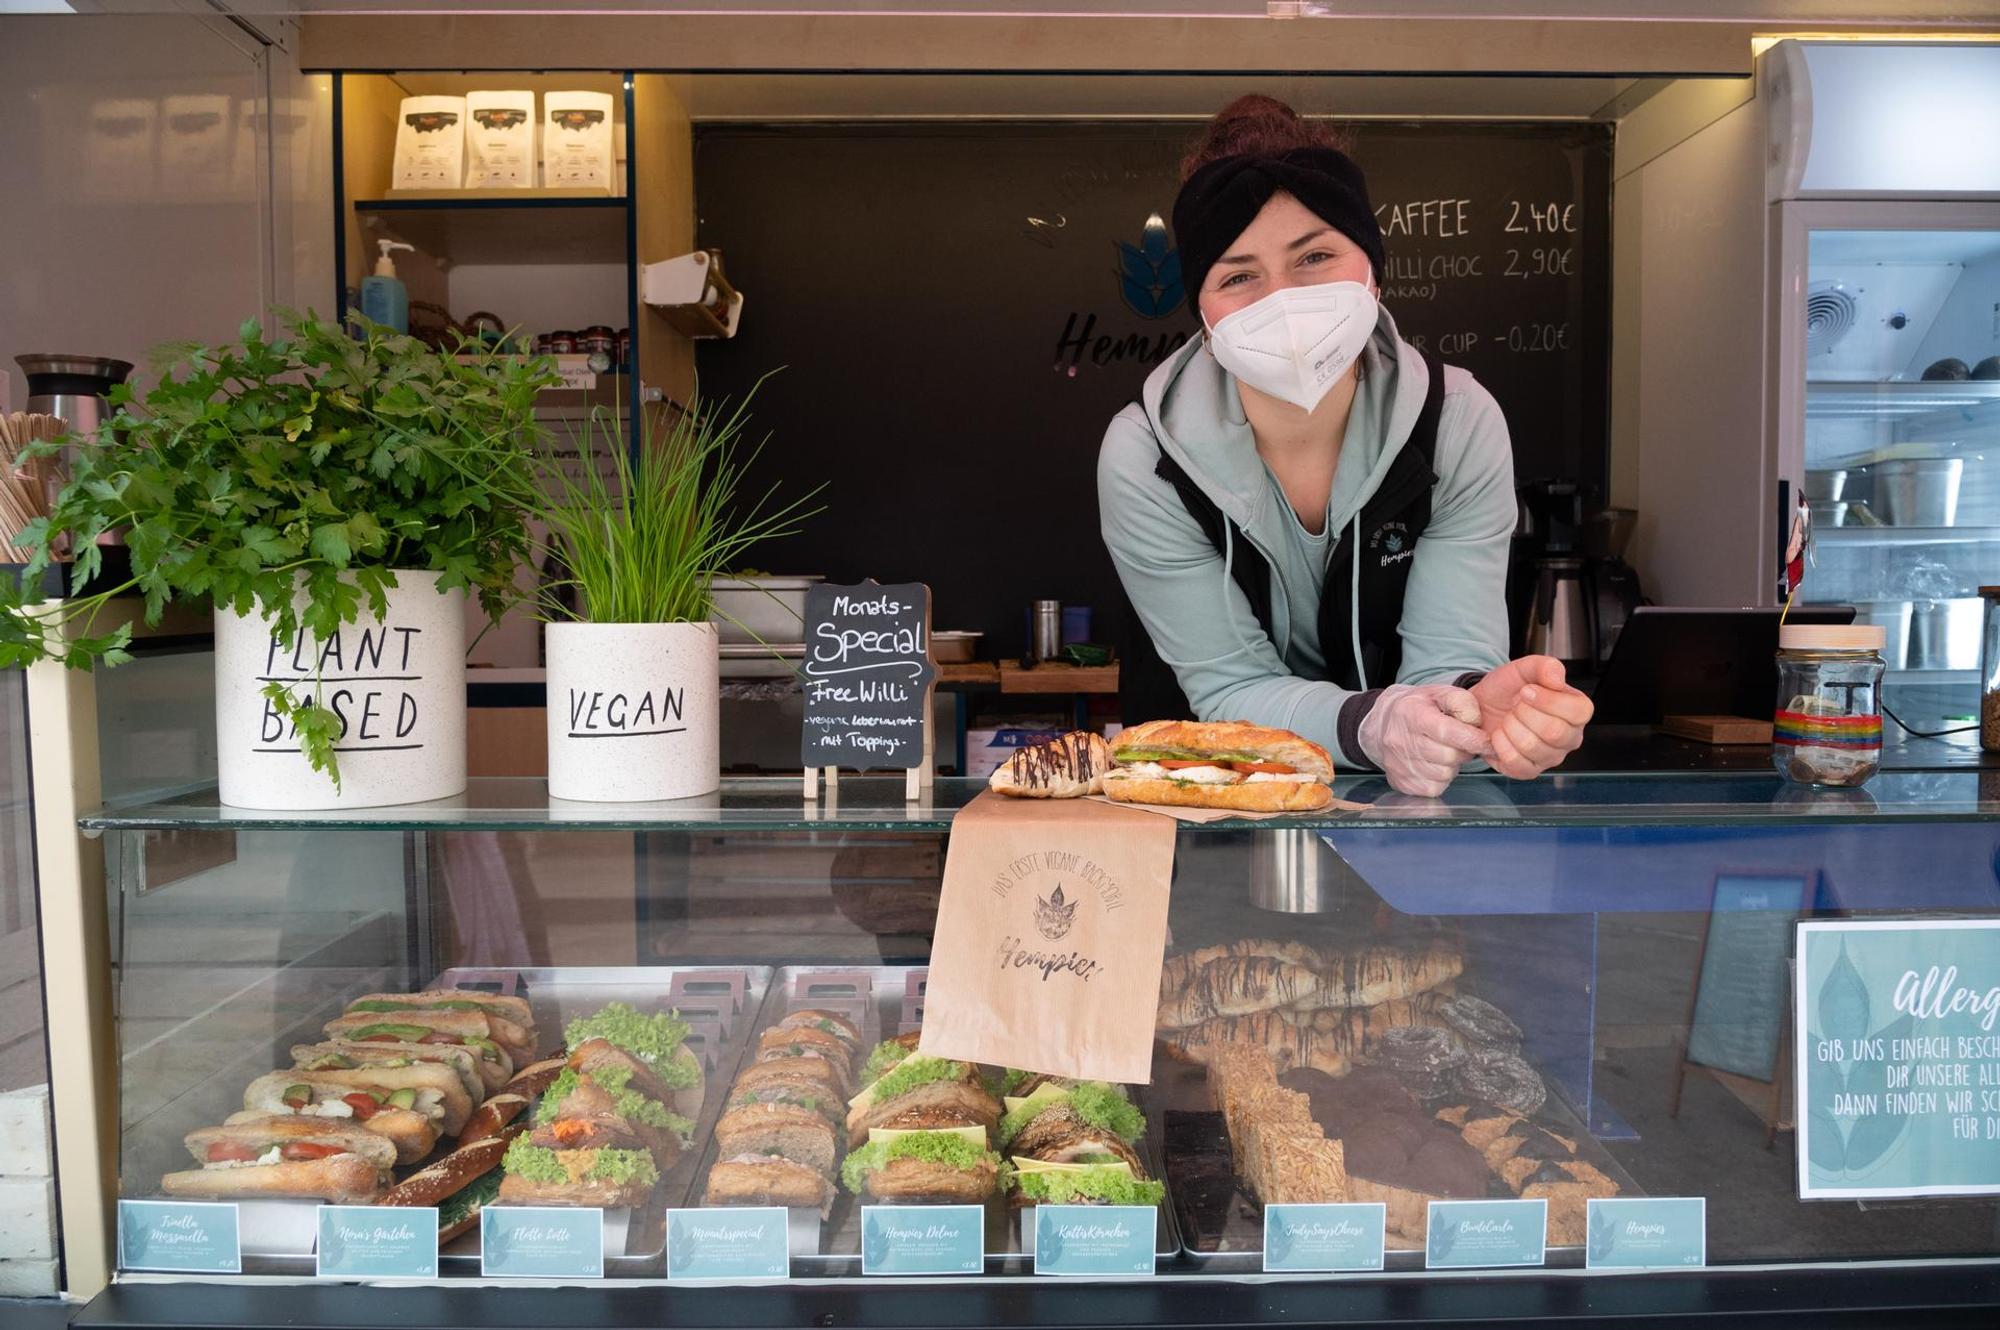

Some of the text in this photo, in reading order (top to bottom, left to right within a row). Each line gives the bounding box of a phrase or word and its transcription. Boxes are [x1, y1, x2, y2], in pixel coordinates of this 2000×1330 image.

[1374, 199, 1470, 237] KAFFEE
[1429, 255, 1482, 279] CHOC
[1503, 248, 1575, 280] 2,90€
[1440, 332, 1479, 354] CUP
[266, 626, 422, 673] PLANT
[813, 621, 926, 663] Special
[806, 679, 909, 703] Free Willi
[569, 687, 686, 730] VEGAN
[1044, 850, 1081, 874] VEGANE
[1817, 1038, 1844, 1062] GIB
[1853, 1038, 1884, 1061] UNS
[1892, 1036, 1950, 1061] EINFACH
[1887, 1064, 1909, 1089] DIR
[1916, 1063, 1970, 1087] UNSERE
[1834, 1089, 2000, 1116] DANN FINDEN WIR SC
[1952, 1114, 1978, 1140] FÜR
[885, 1225, 924, 1242] Hempies
[1626, 1219, 1665, 1238] Hempies
